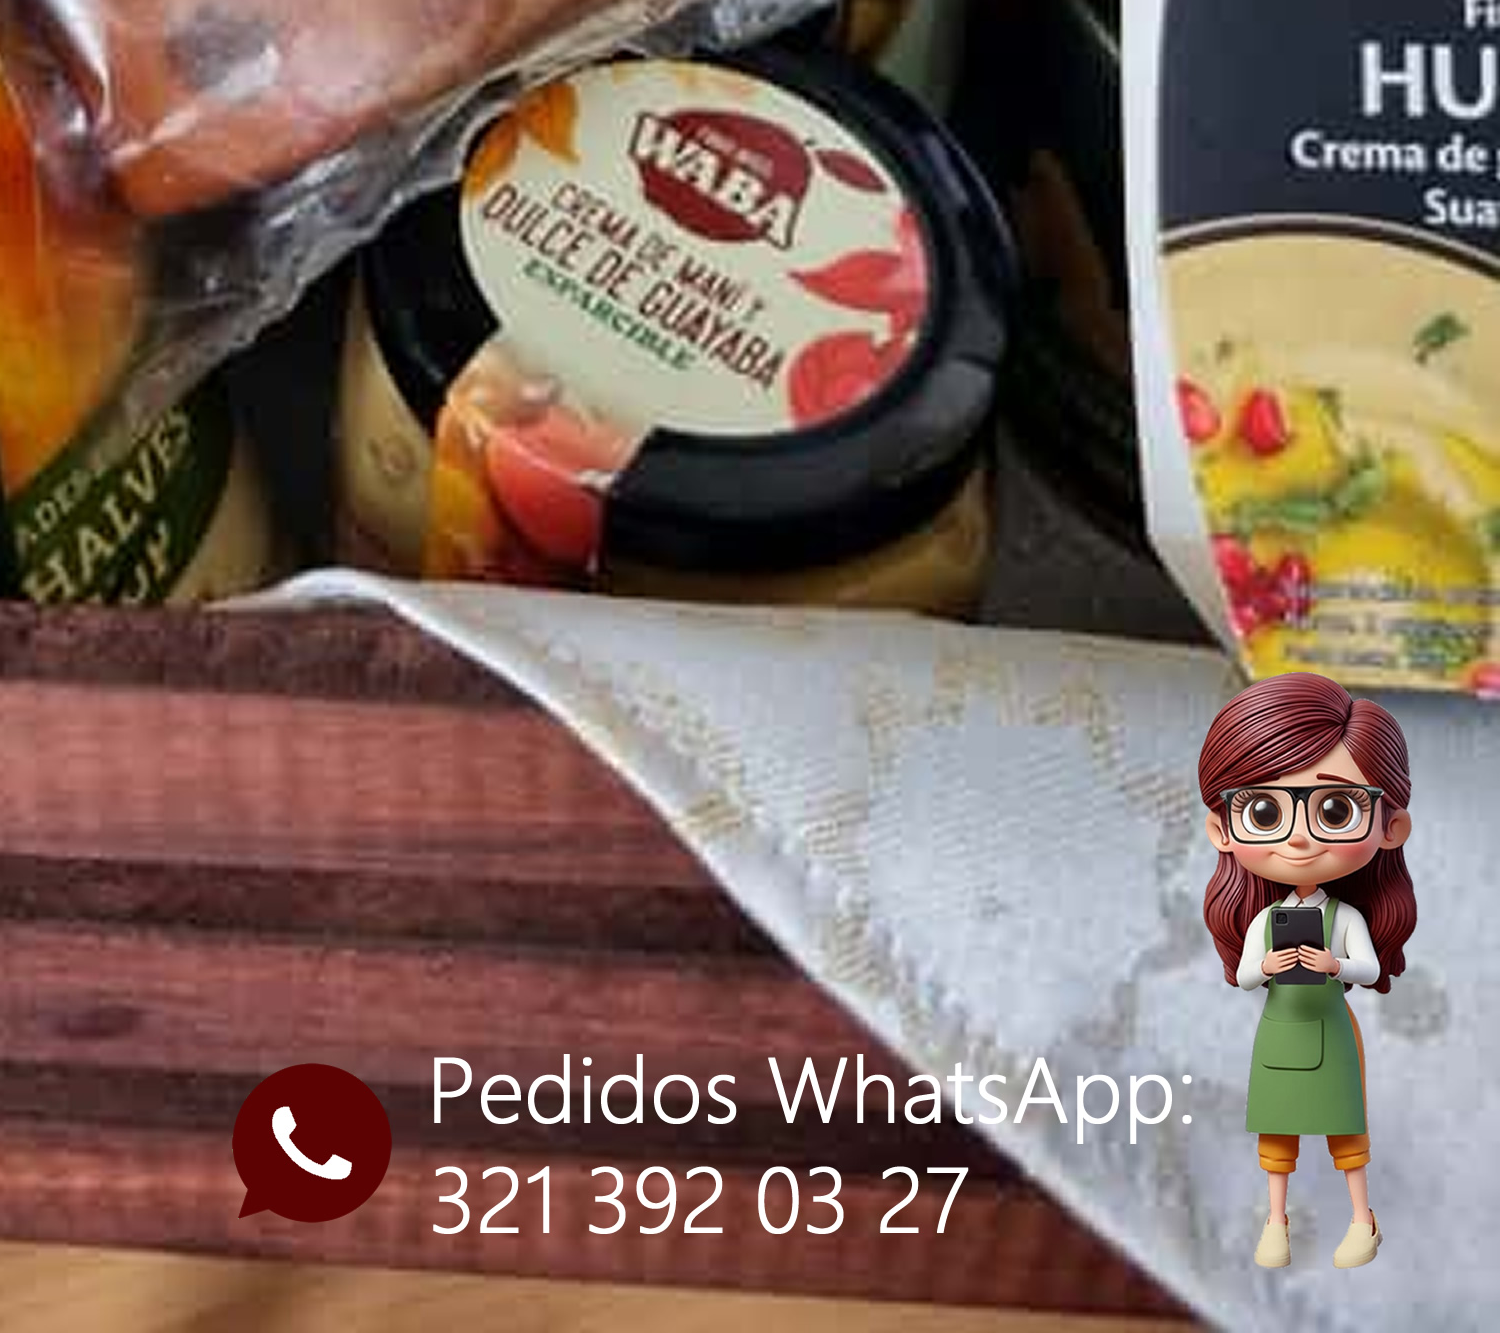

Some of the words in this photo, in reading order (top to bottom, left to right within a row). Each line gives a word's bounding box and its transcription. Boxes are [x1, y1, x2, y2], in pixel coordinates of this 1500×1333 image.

[1360, 40, 1498, 120] HU
[627, 110, 801, 252] WABA
[1290, 129, 1430, 172] Crema
[1435, 131, 1490, 174] de
[550, 182, 641, 249] CREMA
[481, 182, 594, 273] DULCE
[584, 248, 646, 303] DE
[637, 281, 787, 391] GUAYABA
